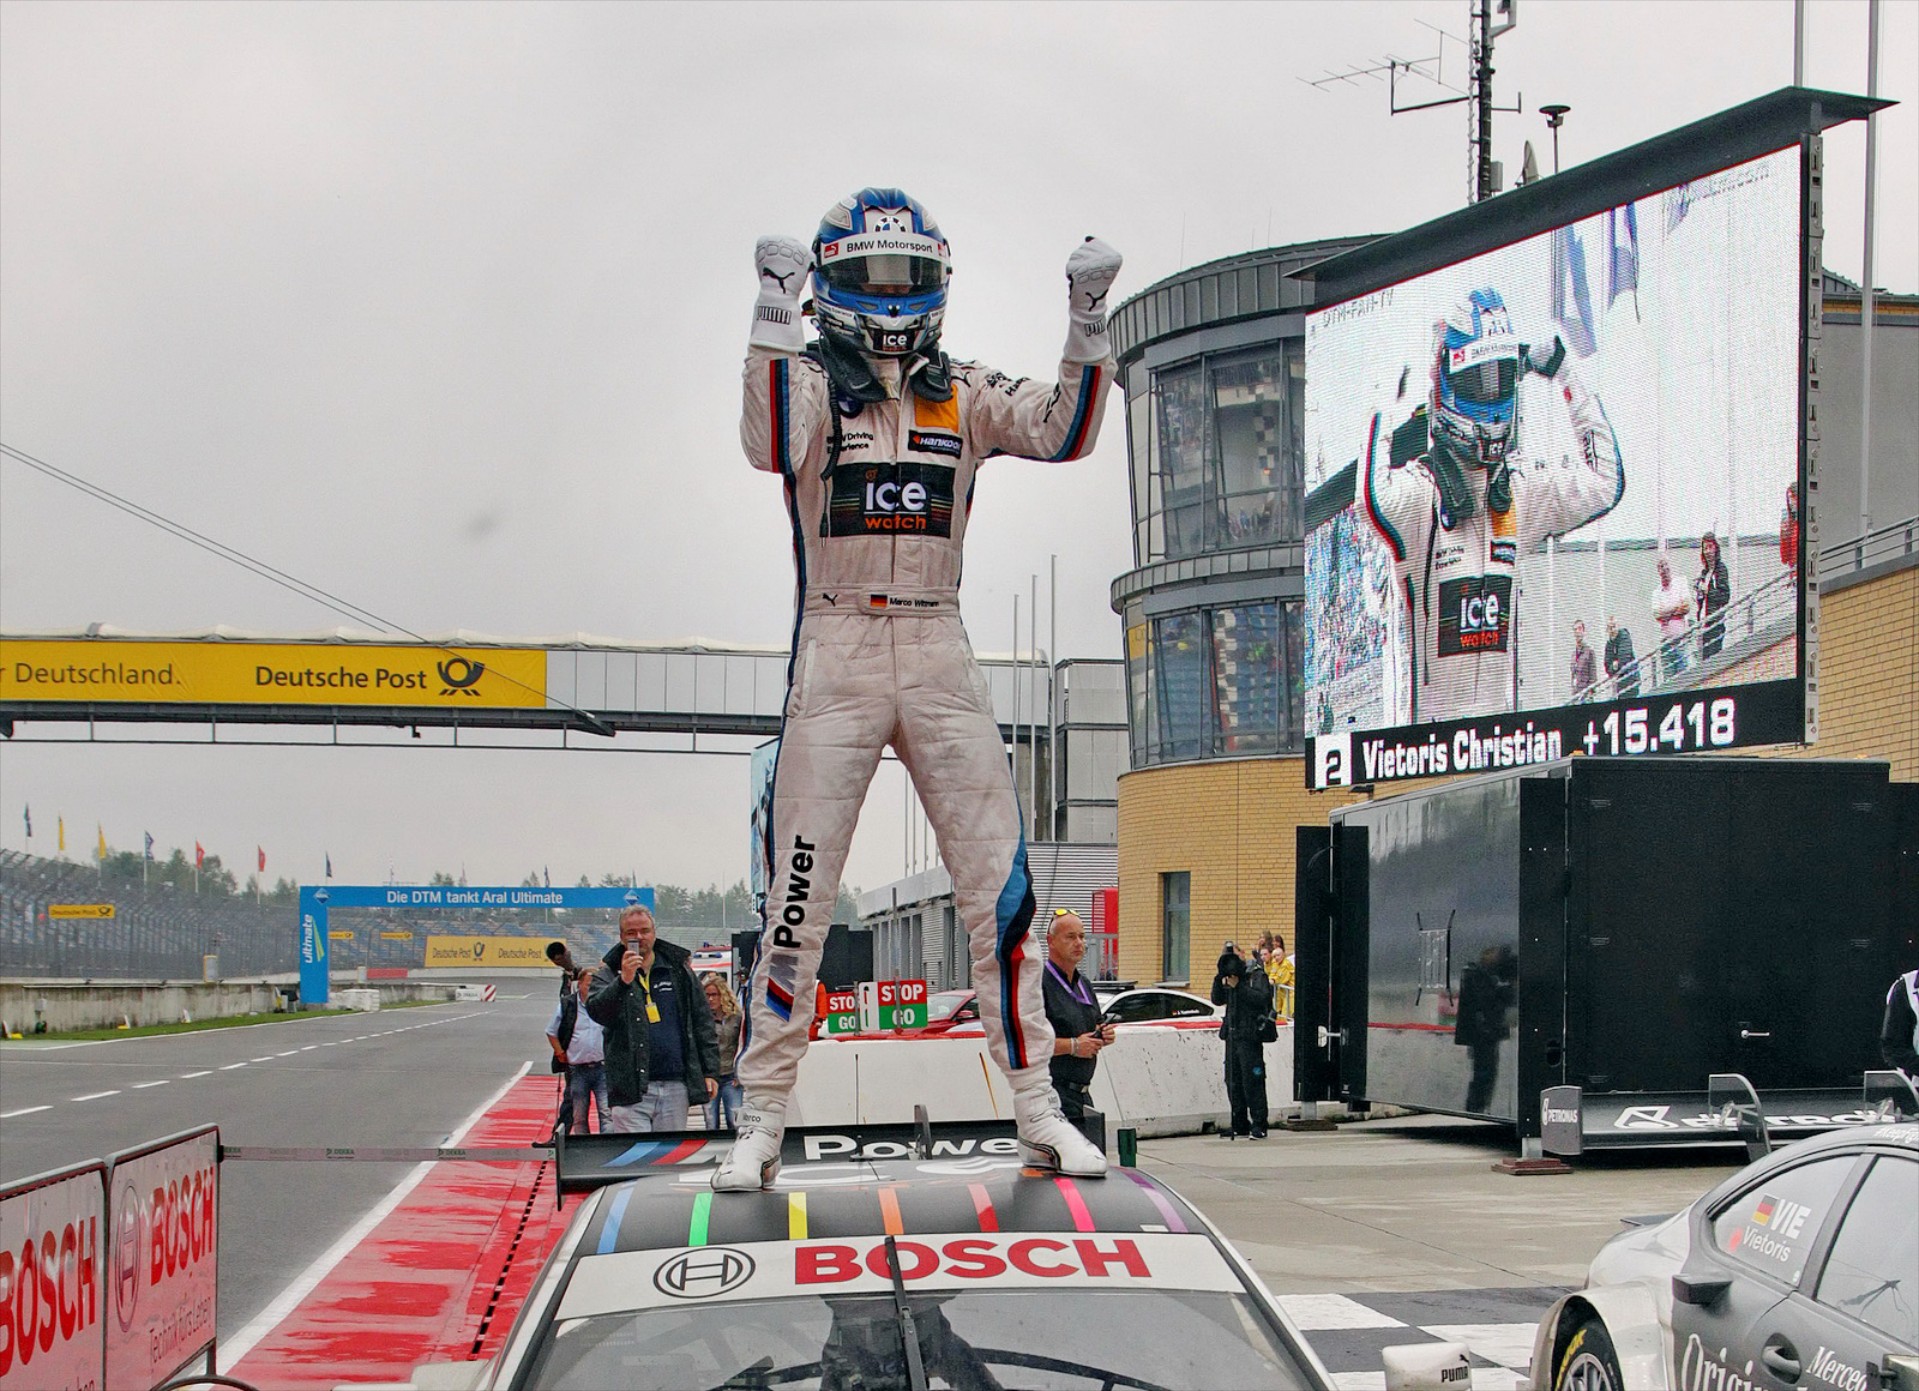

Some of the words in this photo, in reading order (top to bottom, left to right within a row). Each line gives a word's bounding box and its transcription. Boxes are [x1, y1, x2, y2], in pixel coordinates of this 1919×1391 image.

[847, 242, 874, 252] BMW
[877, 240, 933, 253] Motorsport
[882, 334, 908, 346] ice
[848, 432, 874, 441] Driving
[865, 482, 927, 511] ice
[865, 514, 927, 529] watch
[889, 598, 913, 607] Marco
[1460, 593, 1499, 629] ice
[1460, 630, 1500, 648] watch
[16, 662, 181, 685] Deutschland.
[256, 666, 369, 688] Deutsche
[376, 668, 427, 689] Post
[1317, 748, 1341, 781] 2
[1363, 734, 1449, 780] Vietoris
[1453, 722, 1562, 772] Christian
[1583, 698, 1736, 756] +15.418
[387, 891, 408, 903] Die
[412, 891, 441, 903] DTM
[446, 892, 479, 904] tankt
[482, 891, 507, 904] Aral
[511, 892, 563, 904] Ultimate
[773, 834, 815, 948] Power
[302, 914, 313, 963] ultimate
[432, 947, 457, 959] Deutsche
[458, 947, 471, 959] Post
[498, 947, 526, 959] Deutsche
[528, 947, 542, 959] Post
[829, 995, 855, 1011] STO
[803, 1134, 1019, 1161] Powe
[150, 1166, 214, 1286] BOSCH
[1770, 1199, 1812, 1239] VIE
[1743, 1226, 1791, 1262] Vietoris
[795, 1238, 1152, 1285] BOSCH
[0, 1216, 96, 1377] BOSCH
[1441, 1366, 1468, 1383] PUMA
